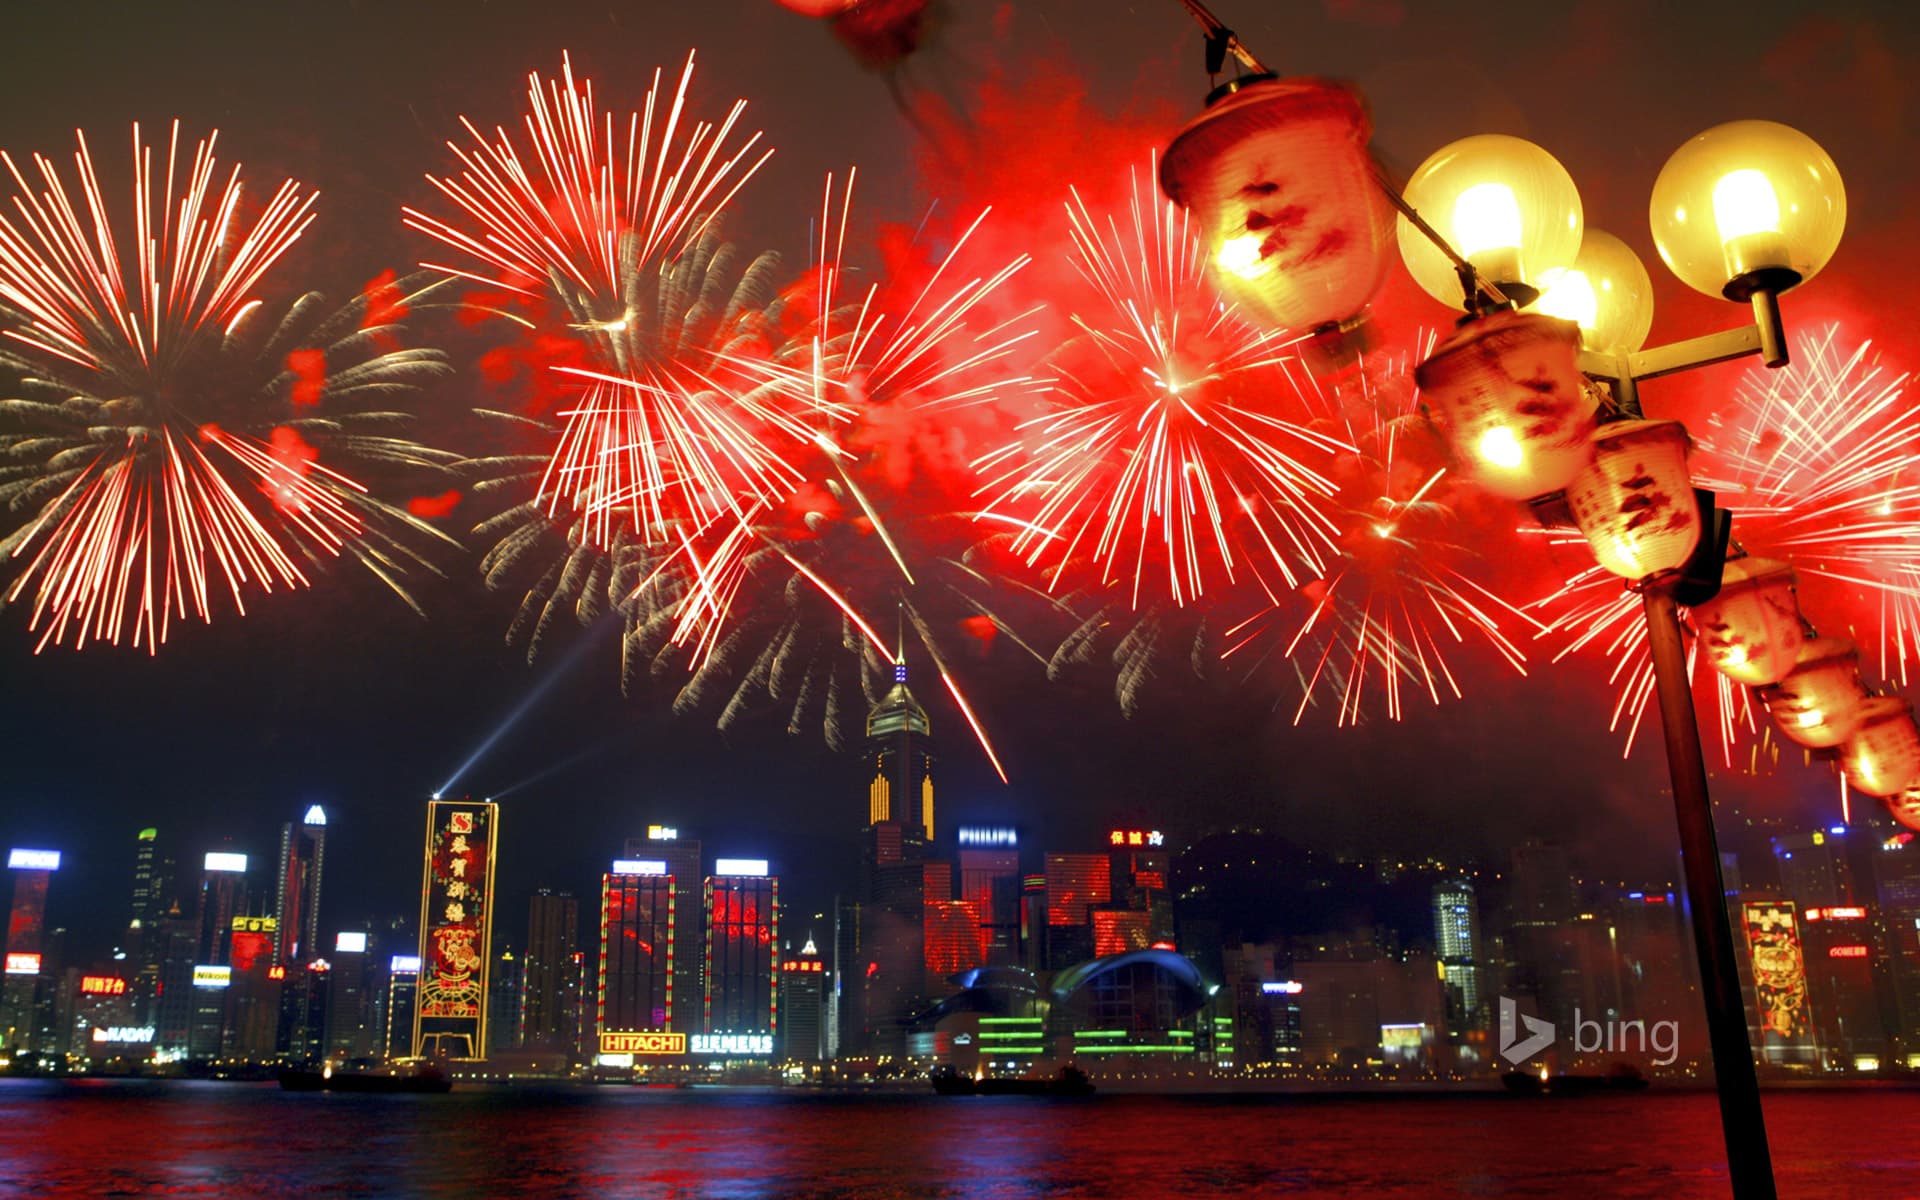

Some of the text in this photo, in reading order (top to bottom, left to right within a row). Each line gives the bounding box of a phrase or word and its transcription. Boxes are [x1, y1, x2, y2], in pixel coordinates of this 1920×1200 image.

[959, 827, 1017, 845] PHILIPS
[196, 971, 228, 980] Nikon
[605, 1036, 681, 1050] HITACHI
[690, 1035, 773, 1052] SIEMENS
